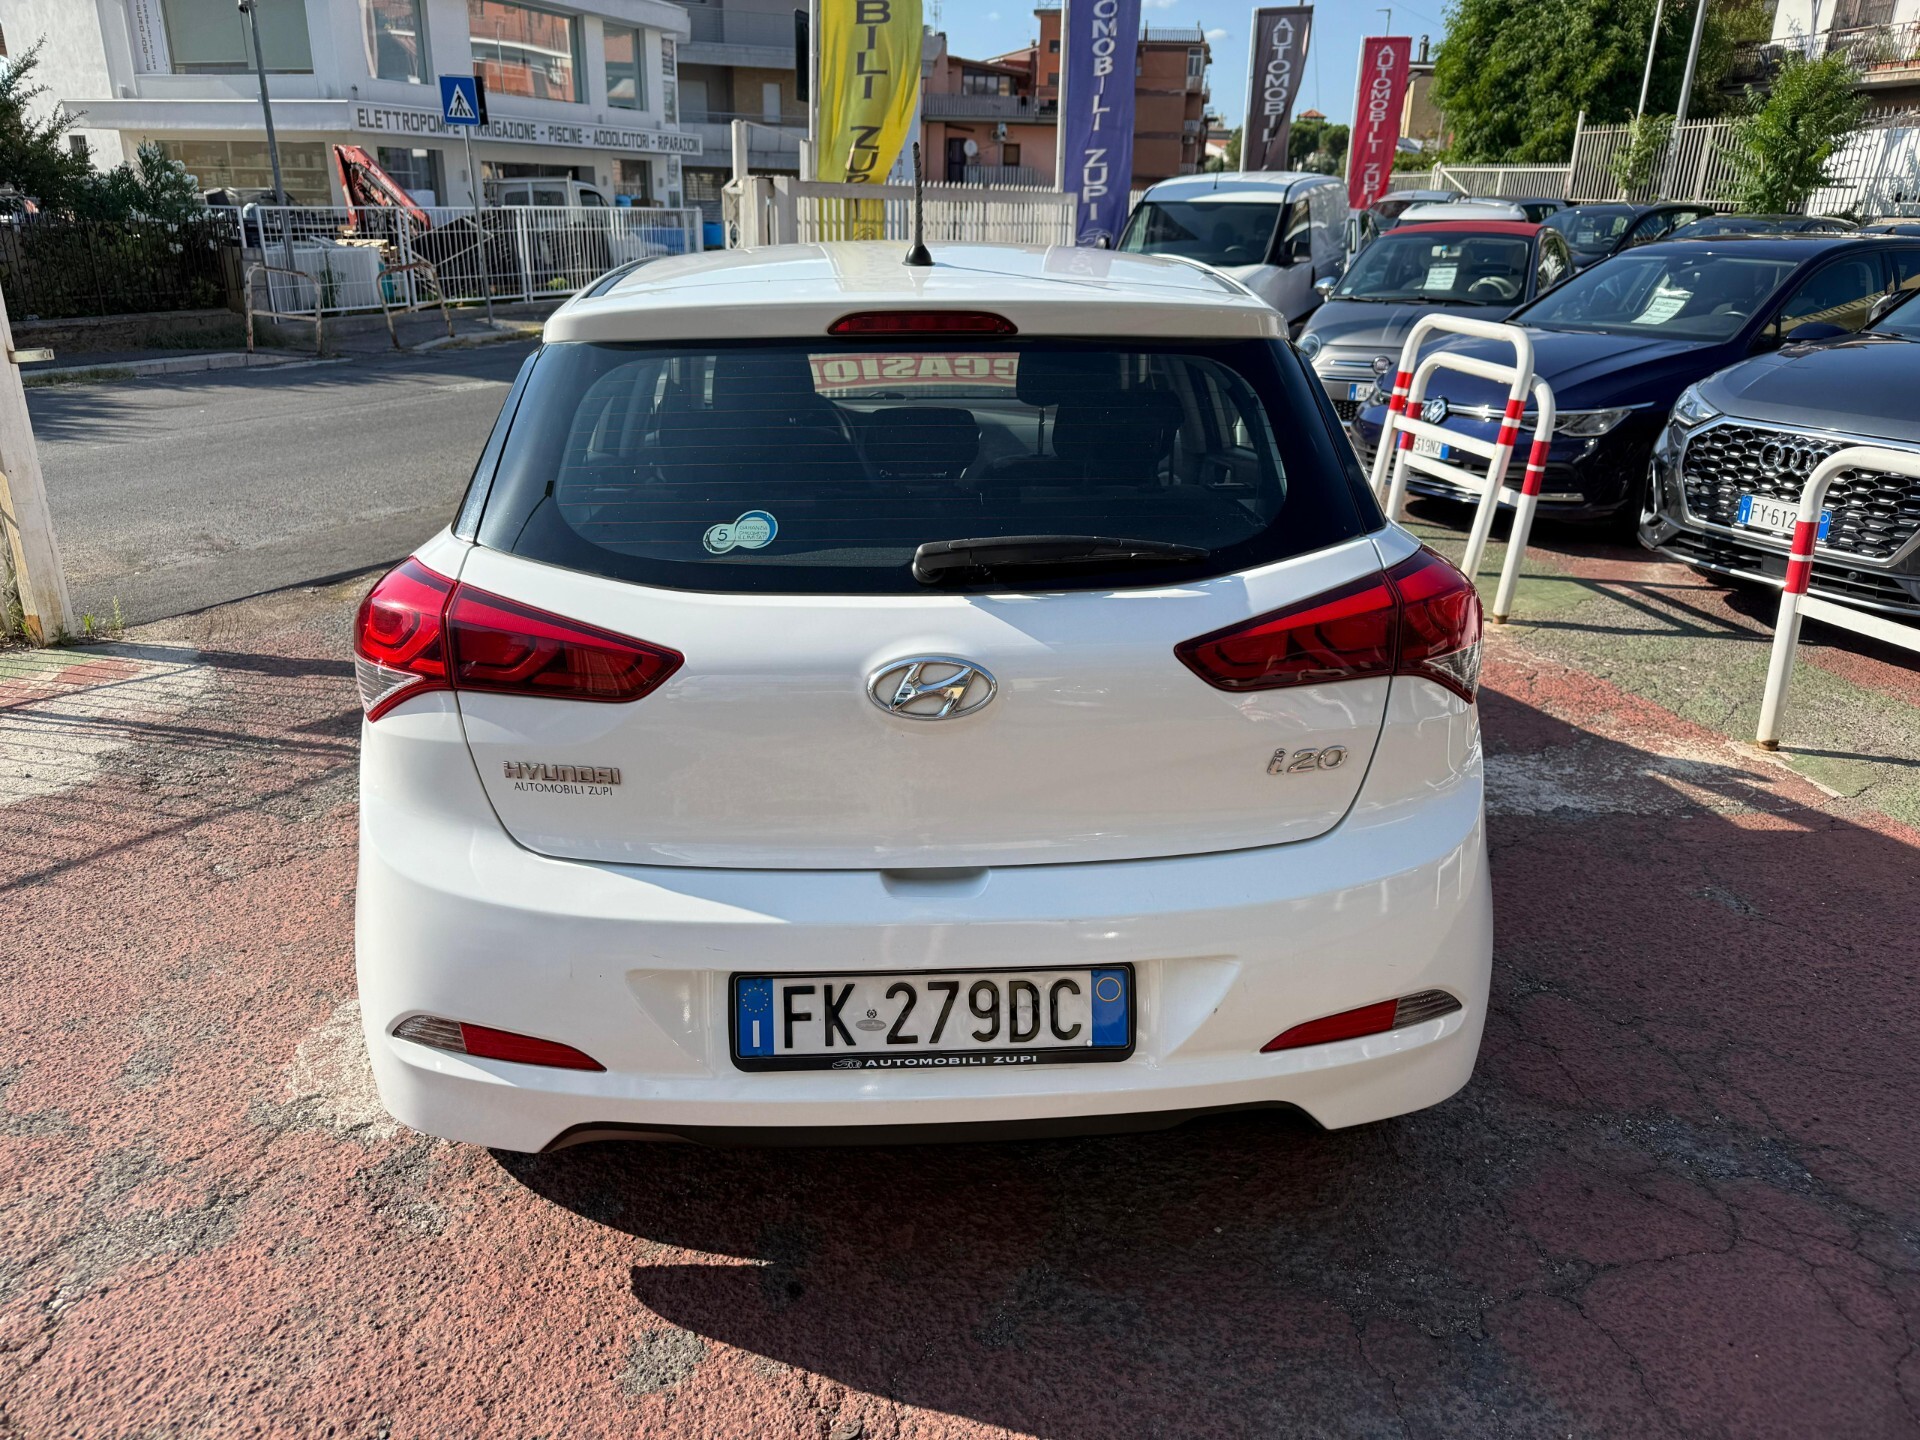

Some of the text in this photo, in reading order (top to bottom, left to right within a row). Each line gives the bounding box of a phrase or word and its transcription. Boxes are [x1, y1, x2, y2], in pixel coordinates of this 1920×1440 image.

[549, 126, 583, 144] PISCINE
[1363, 45, 1395, 205] AUTOMOBILI ZUPI
[1083, 149, 1108, 220] ZUPI
[1750, 503, 1769, 522] FY
[1771, 508, 1798, 530] 612
[717, 528, 728, 542] 5
[1267, 745, 1348, 775] i20
[502, 761, 622, 785] HYUNDAI
[514, 782, 613, 796] AUTOMOBILI ZUPI
[783, 983, 857, 1049] FK
[885, 979, 1082, 1045] 279DC
[865, 1055, 1038, 1068] AUTOMOBILI ZUPI
